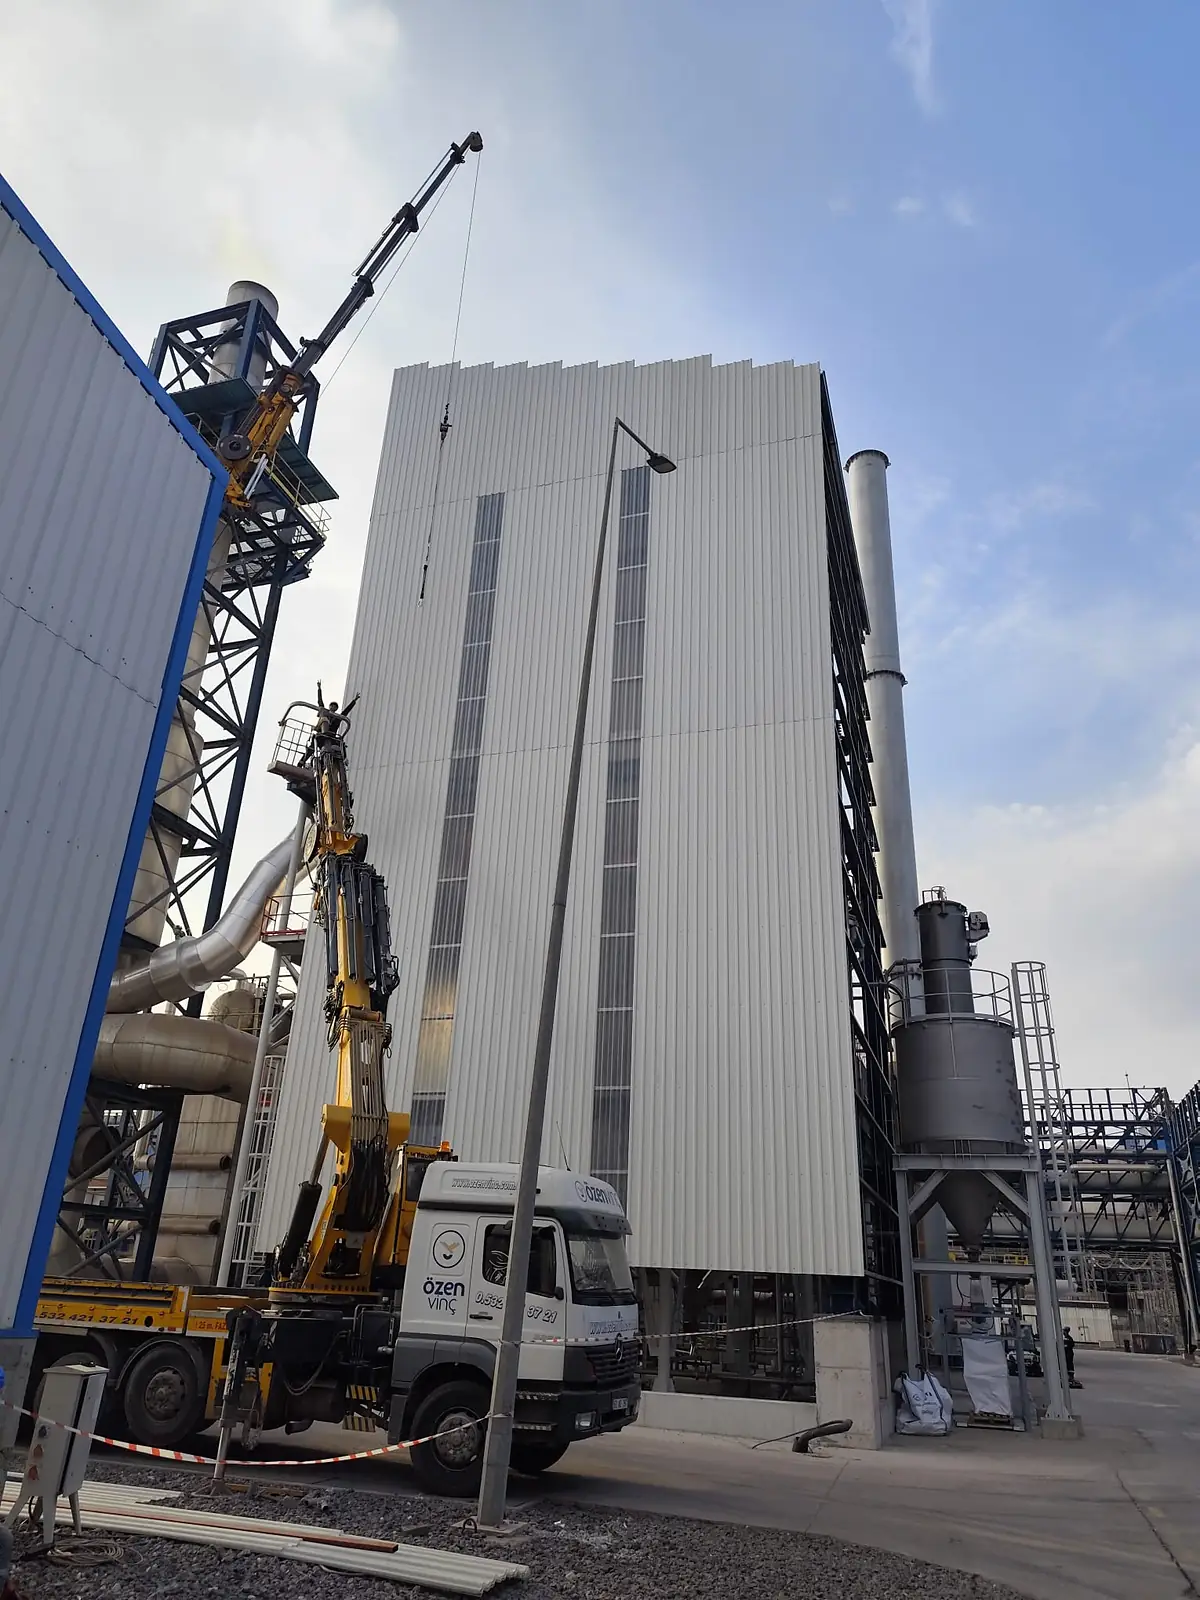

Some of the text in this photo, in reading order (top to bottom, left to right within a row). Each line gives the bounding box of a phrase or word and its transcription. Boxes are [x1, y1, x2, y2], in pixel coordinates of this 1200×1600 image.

[583, 1181, 609, 1204] özen
[423, 1276, 465, 1297] özen
[427, 1297, 457, 1315] vinç
[475, 1290, 558, 1324] 0.532 37 21
[35, 1311, 139, 1325] .532 421 37 21
